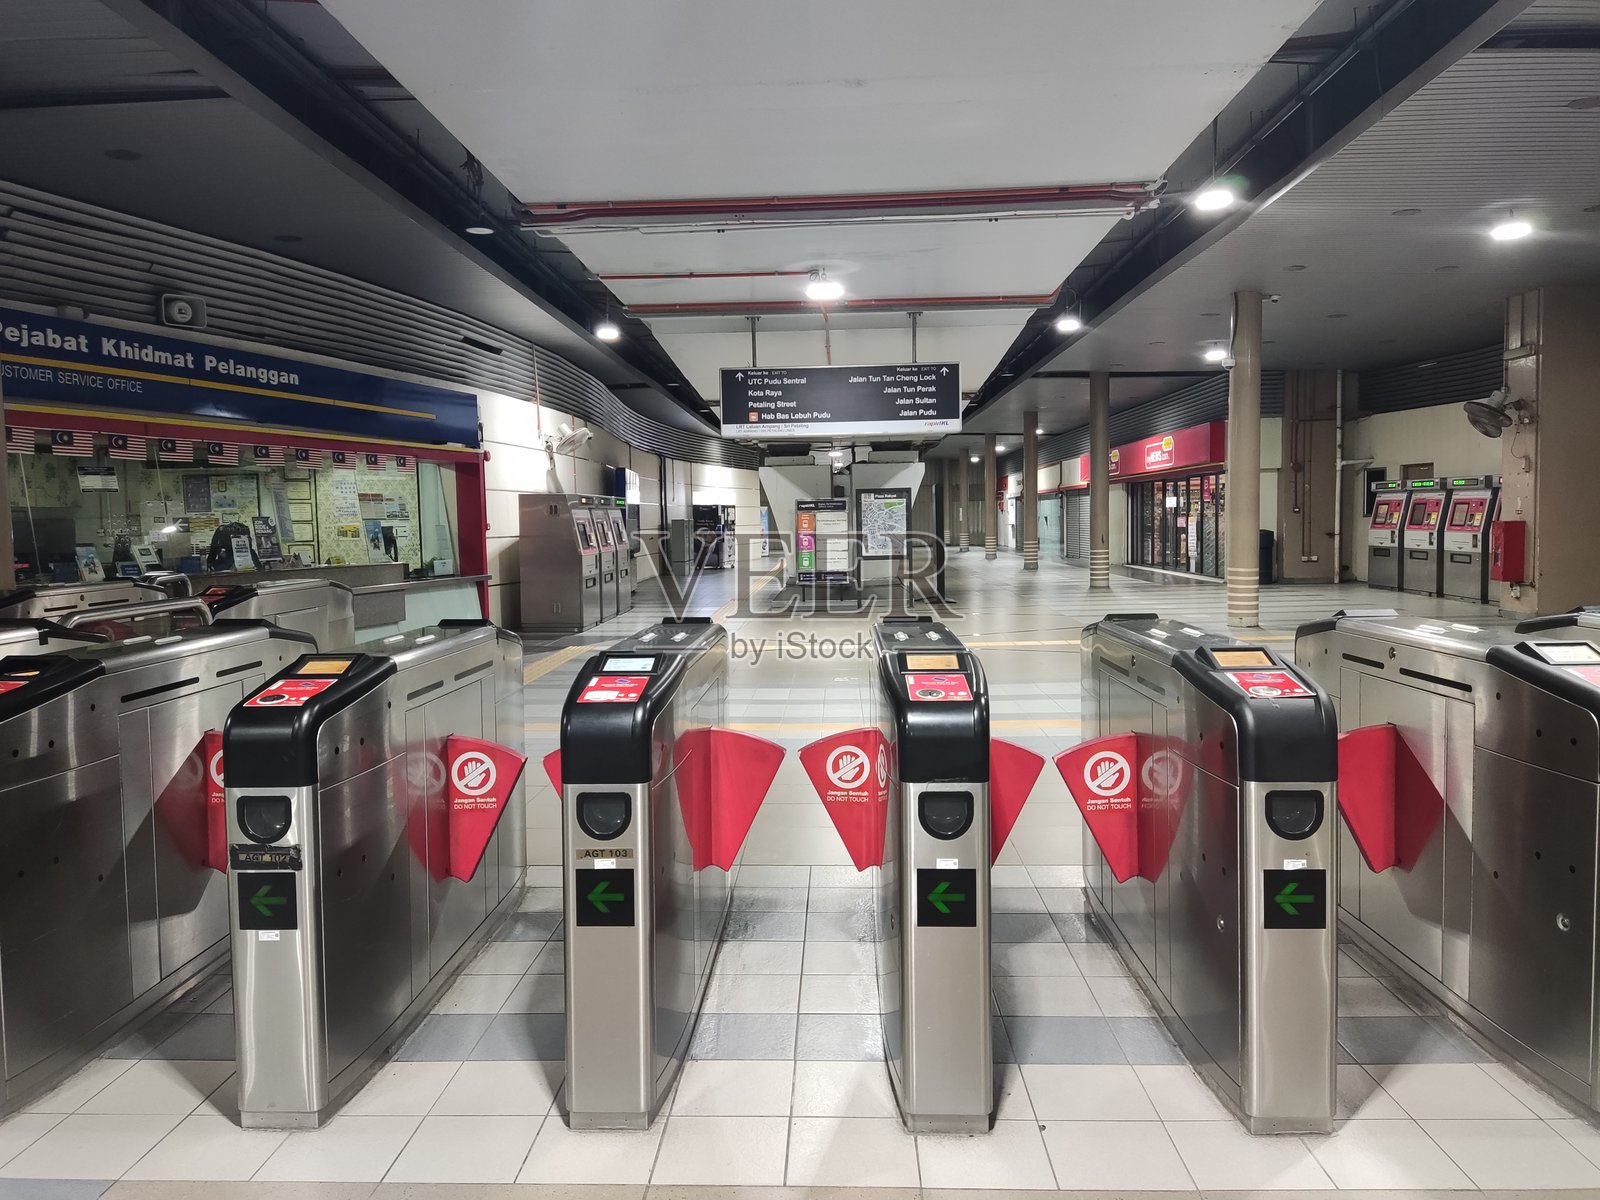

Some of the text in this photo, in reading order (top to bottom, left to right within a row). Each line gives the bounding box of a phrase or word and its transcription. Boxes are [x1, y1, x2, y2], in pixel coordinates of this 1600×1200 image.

[101, 337, 194, 370] Khidmat
[204, 355, 299, 385] Pelanggan
[783, 377, 807, 385] Sentral
[896, 374, 918, 382] Cheng
[58, 372, 104, 389] SERVICE
[107, 378, 143, 393] OFFICE
[765, 390, 782, 398] Raya
[748, 401, 775, 409] Petaling
[584, 849, 628, 858] AGT 103
